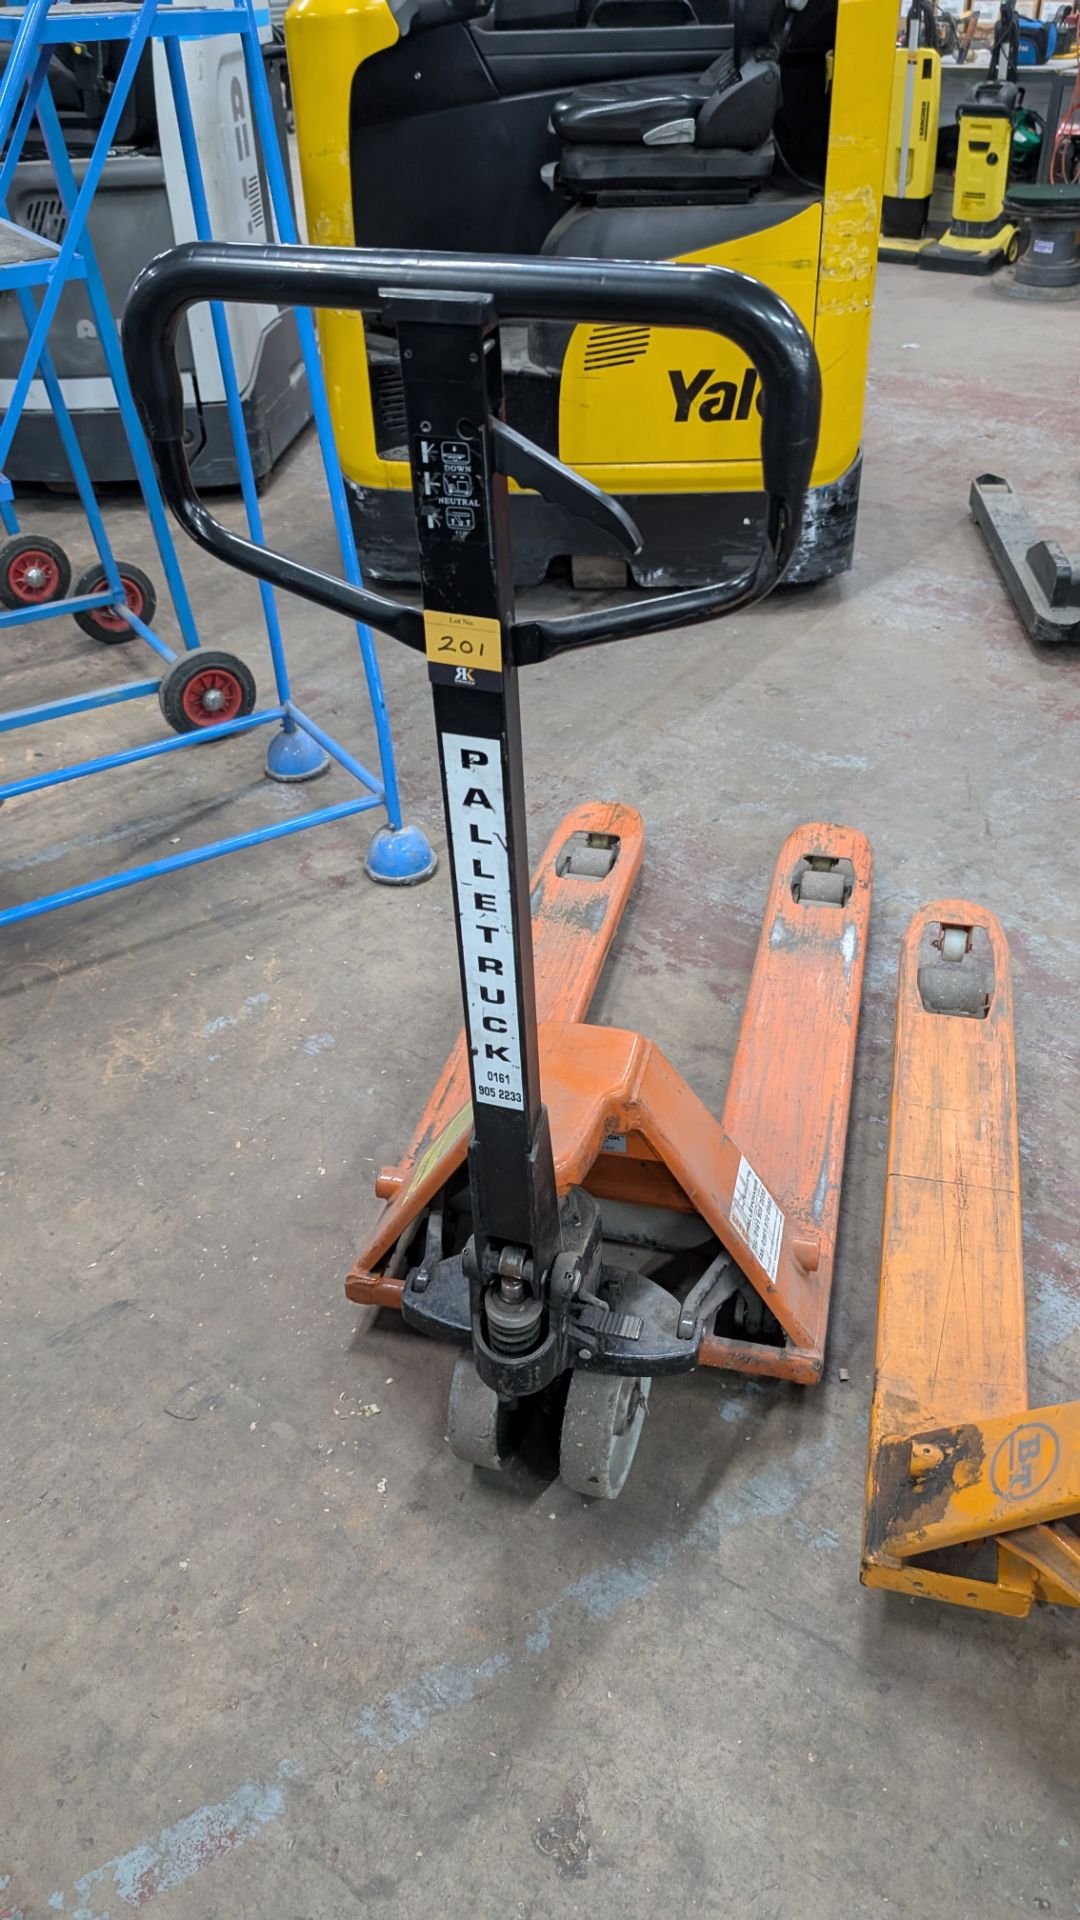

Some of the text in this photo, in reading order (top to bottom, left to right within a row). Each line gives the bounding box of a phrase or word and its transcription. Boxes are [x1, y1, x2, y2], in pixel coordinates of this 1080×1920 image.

[444, 464, 472, 473] DOWN
[438, 497, 481, 507] NEUTRAL
[449, 617, 461, 625] Lot
[437, 635, 484, 656] 201
[487, 1071, 510, 1085] 0161
[478, 1085, 522, 1103] 905 2233
